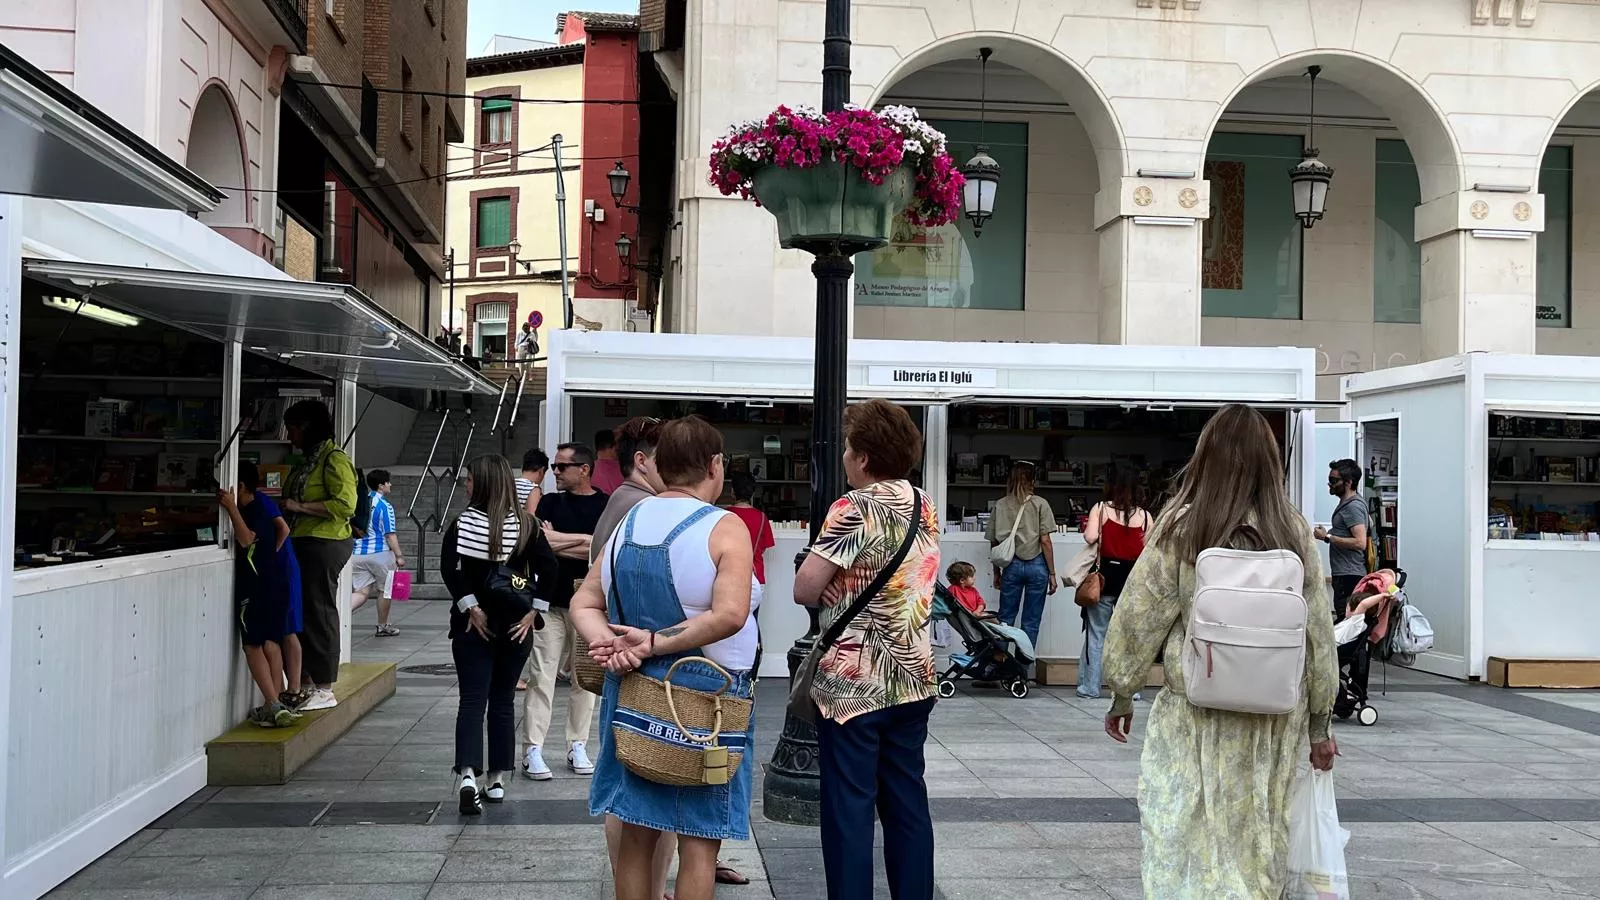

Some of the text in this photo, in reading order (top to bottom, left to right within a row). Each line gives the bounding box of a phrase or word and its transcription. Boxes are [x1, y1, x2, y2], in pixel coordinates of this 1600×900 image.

[893, 370, 972, 384] Librería El Iglú
[648, 723, 662, 735] RB
